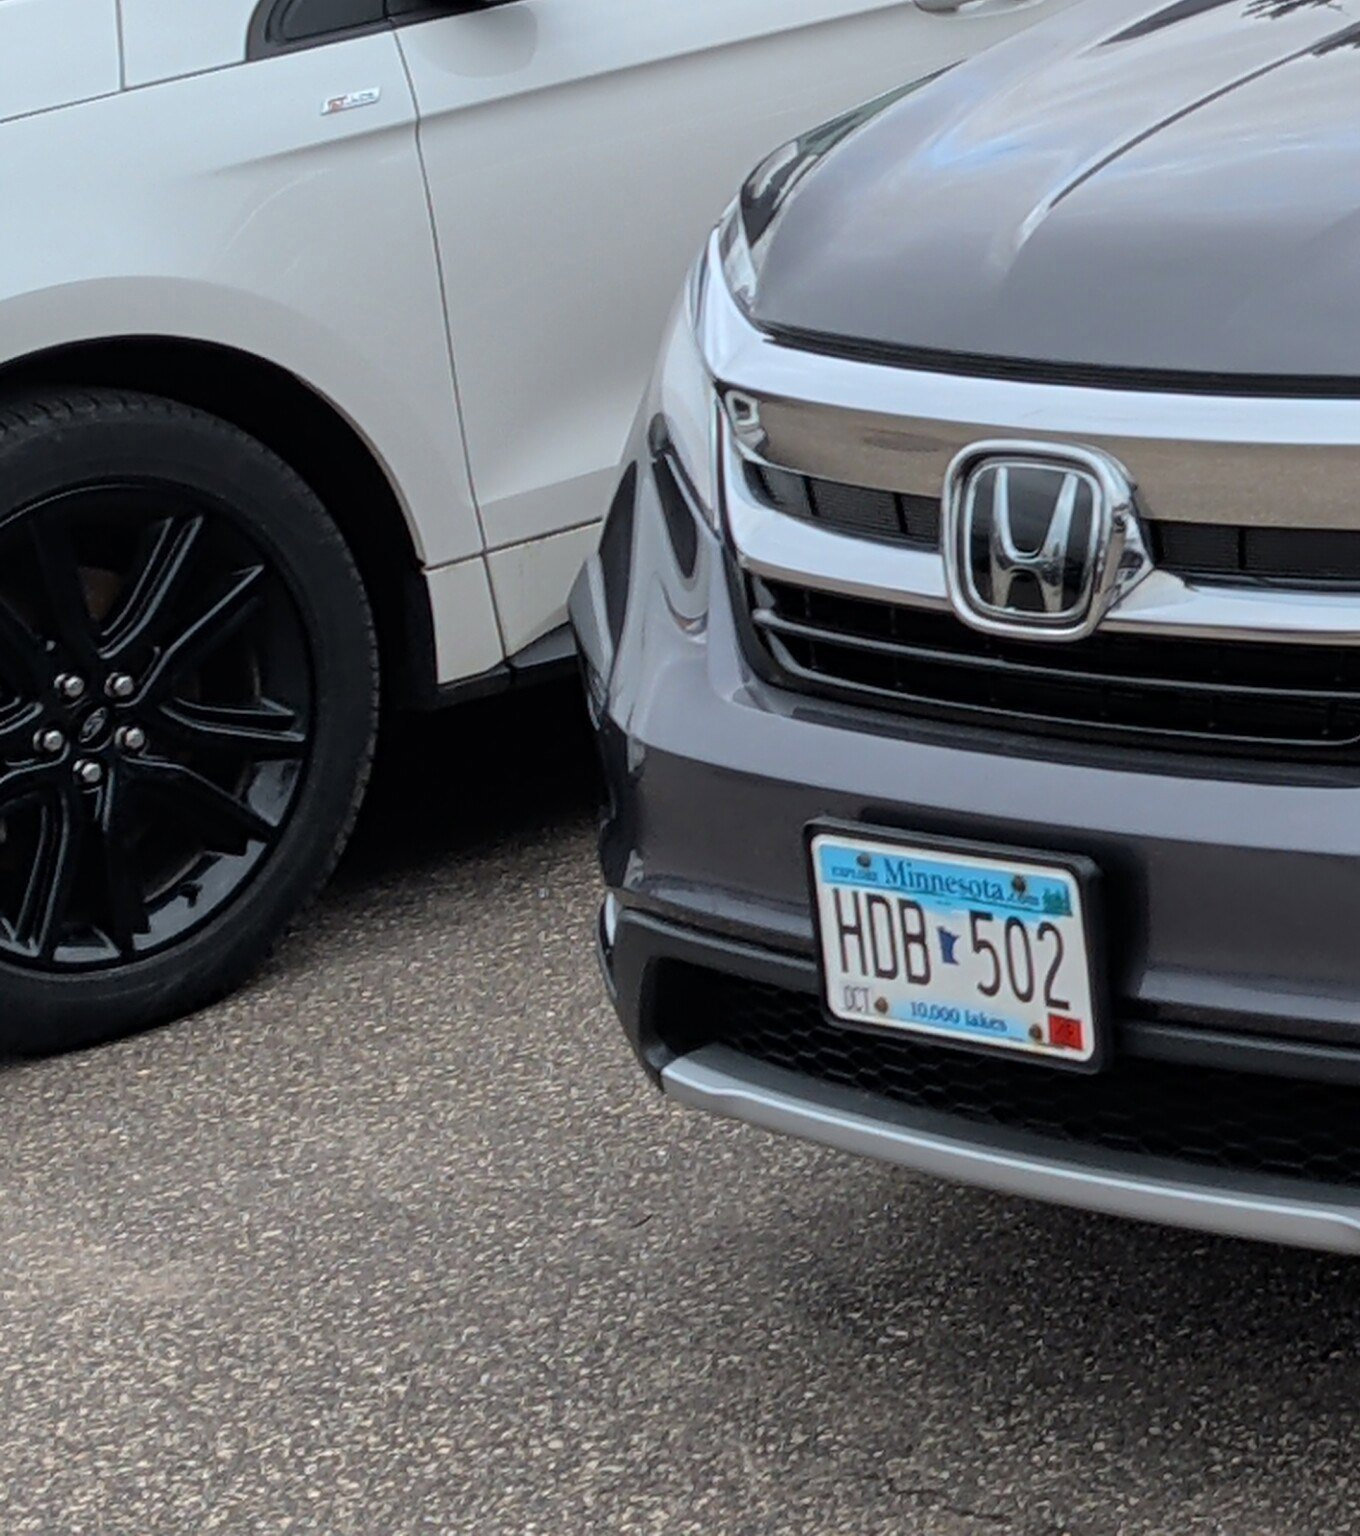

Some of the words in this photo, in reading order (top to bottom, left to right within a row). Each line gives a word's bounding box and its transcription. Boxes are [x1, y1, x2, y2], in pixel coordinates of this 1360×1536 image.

[832, 887, 932, 986] HDB
[969, 909, 1071, 1011] 502
[841, 984, 871, 1014] OCT
[910, 1000, 960, 1025] 10,000
[964, 1009, 1008, 1033] lakes
